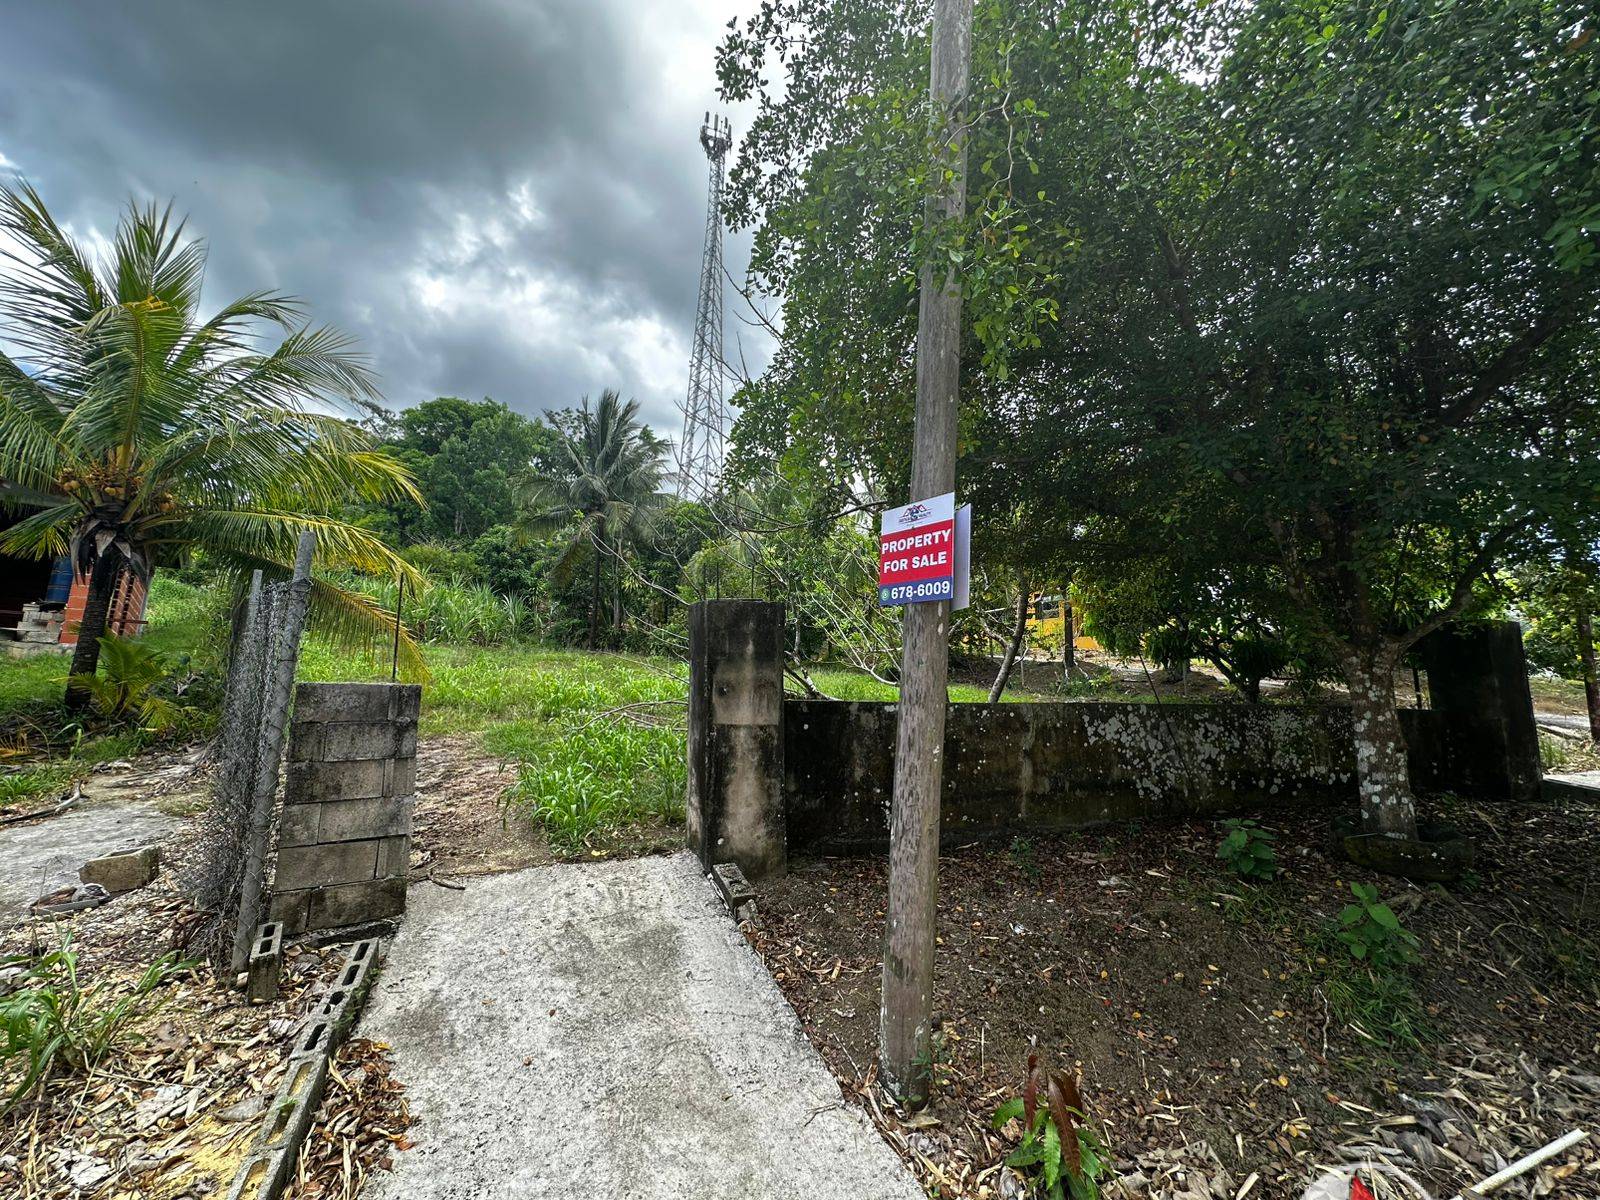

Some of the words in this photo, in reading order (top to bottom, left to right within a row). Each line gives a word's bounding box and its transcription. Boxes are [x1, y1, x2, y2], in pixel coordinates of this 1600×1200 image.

[882, 529, 951, 554] PROPERTY
[884, 559, 908, 573] FOR
[912, 551, 947, 569] SALE
[891, 581, 950, 600] 678-6009
